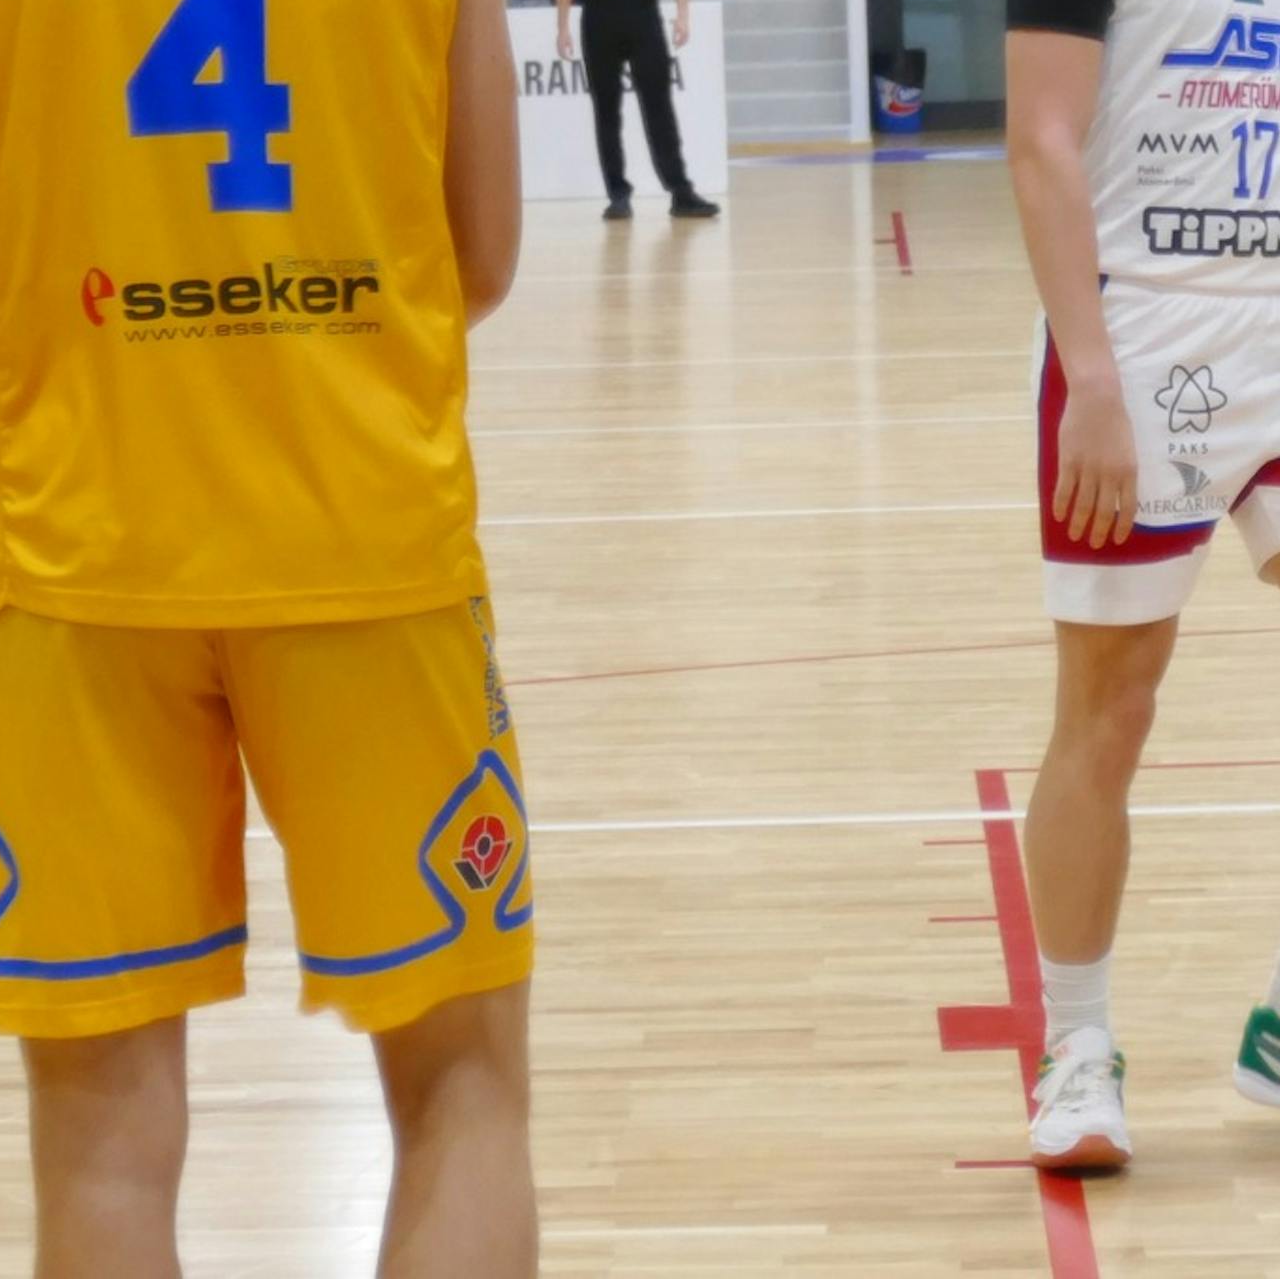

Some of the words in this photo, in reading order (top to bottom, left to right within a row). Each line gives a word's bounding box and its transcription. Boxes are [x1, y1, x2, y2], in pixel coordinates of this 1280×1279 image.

[1137, 133, 1219, 154] MVM
[1232, 120, 1279, 199] 17
[82, 262, 379, 327] esseker
[1168, 442, 1209, 455] PAKS
